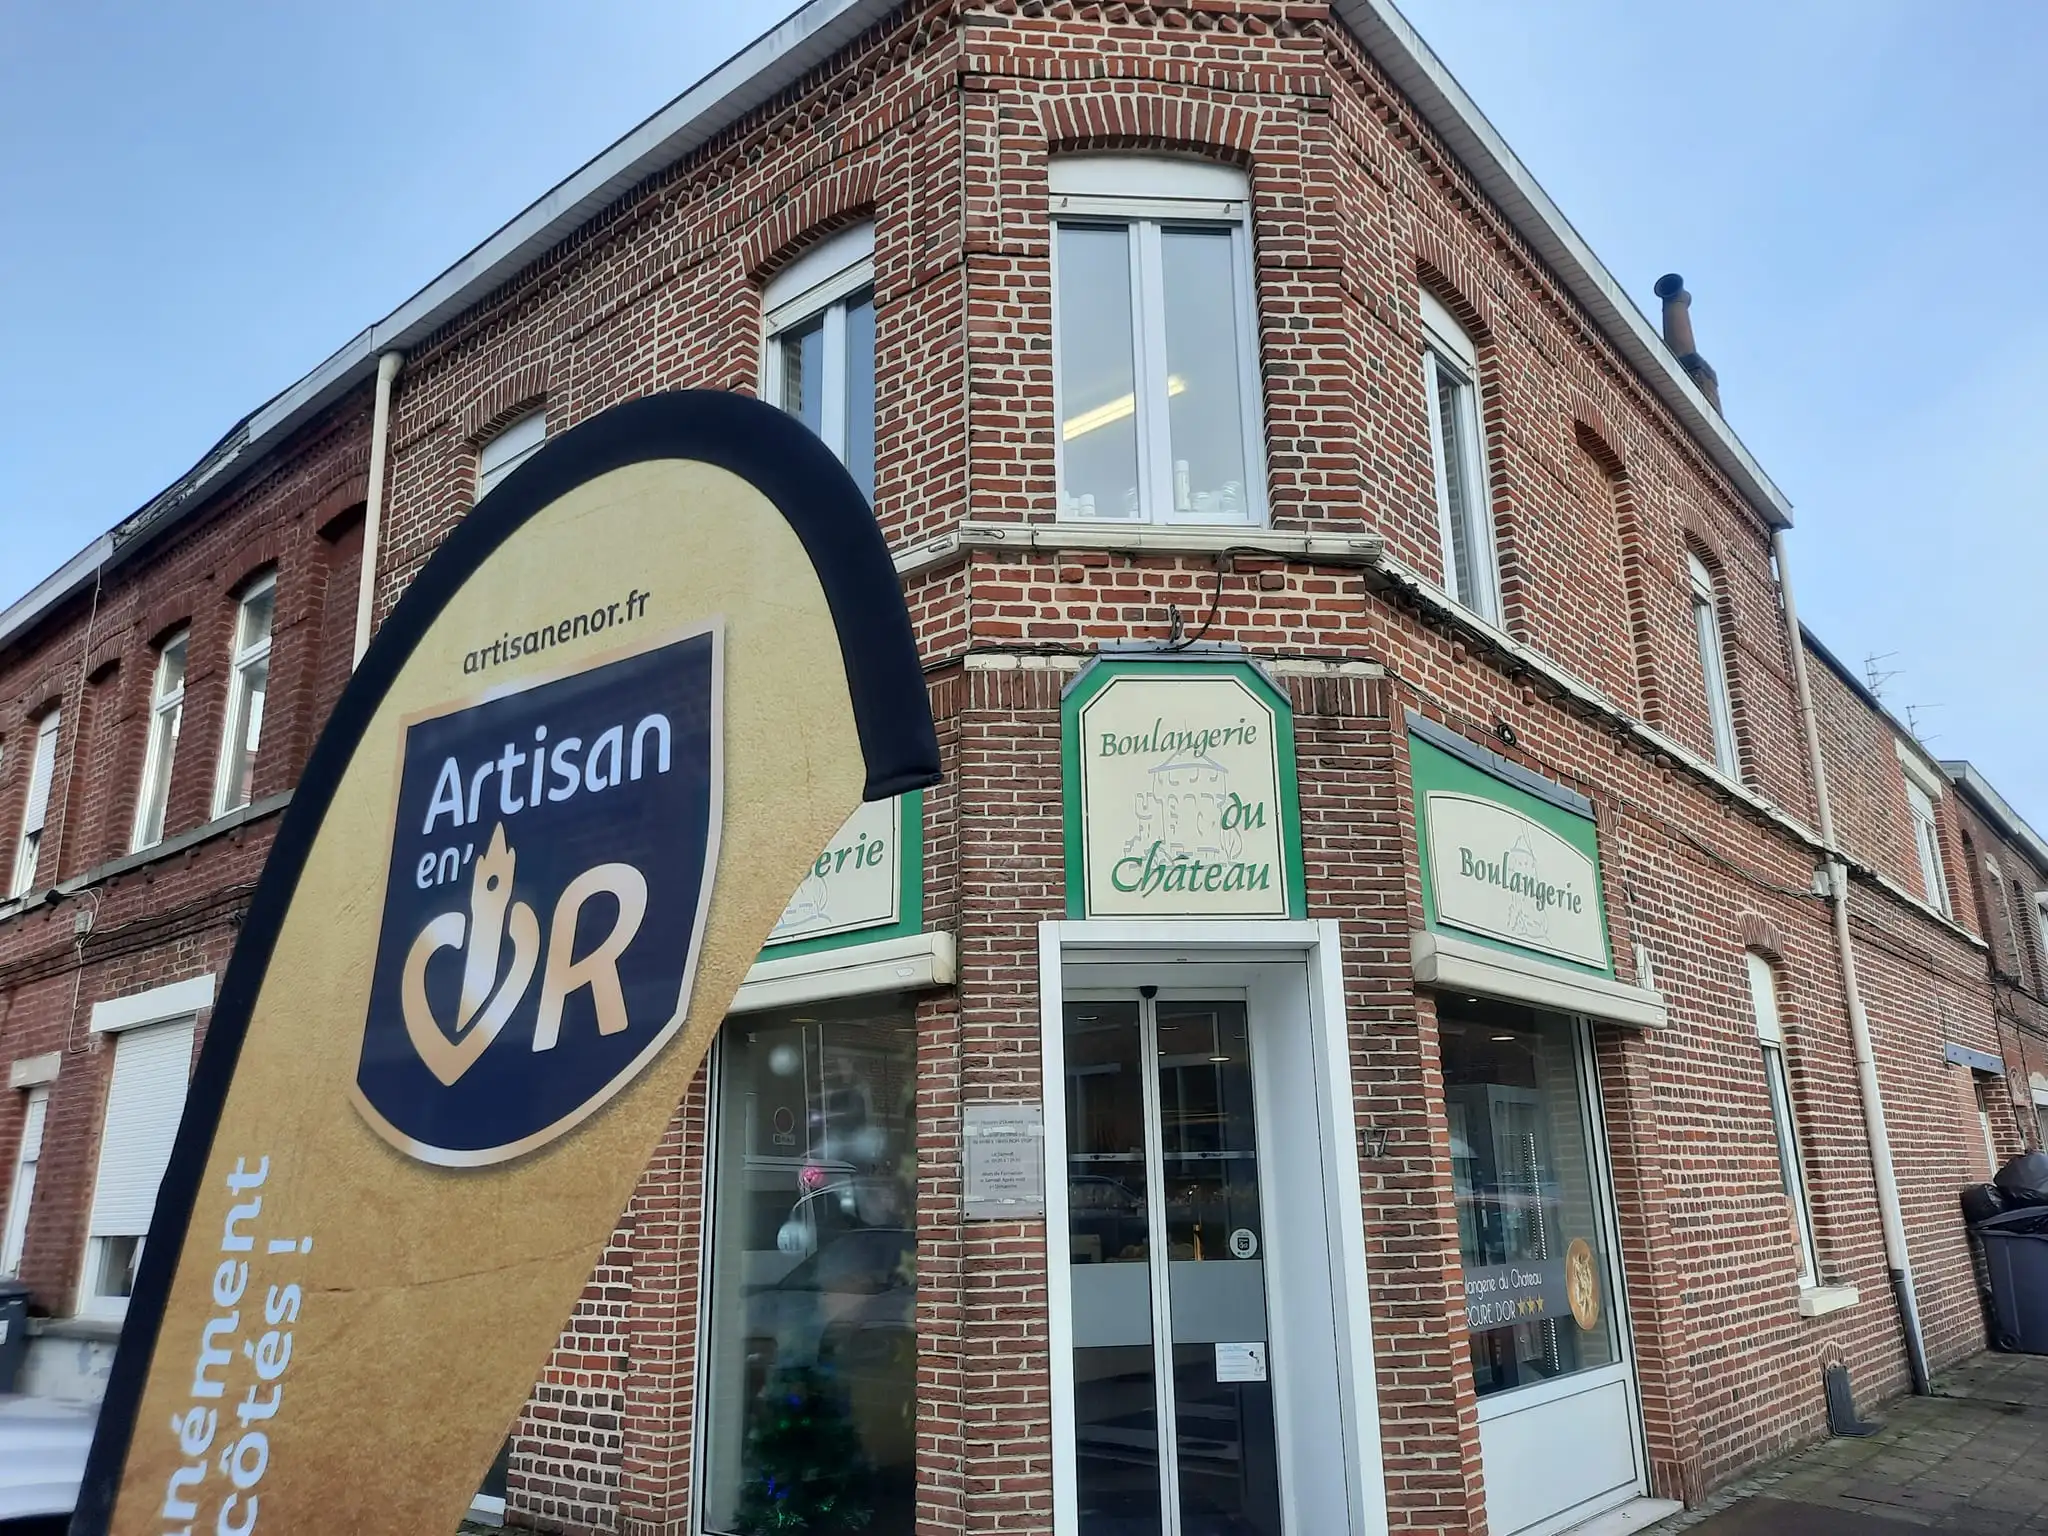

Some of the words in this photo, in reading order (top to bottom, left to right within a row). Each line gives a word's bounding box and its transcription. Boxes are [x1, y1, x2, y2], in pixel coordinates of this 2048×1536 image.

[463, 589, 651, 675] artisanenor.fr
[1099, 717, 1258, 758] Boulangerie
[422, 712, 673, 836] Artisan
[1221, 792, 1267, 831] du
[805, 832, 885, 880] erie
[1111, 840, 1271, 898] Château
[1459, 847, 1583, 915] Boulangerie
[1498, 1270, 1509, 1290] du
[162, 1155, 269, 1536] nément
